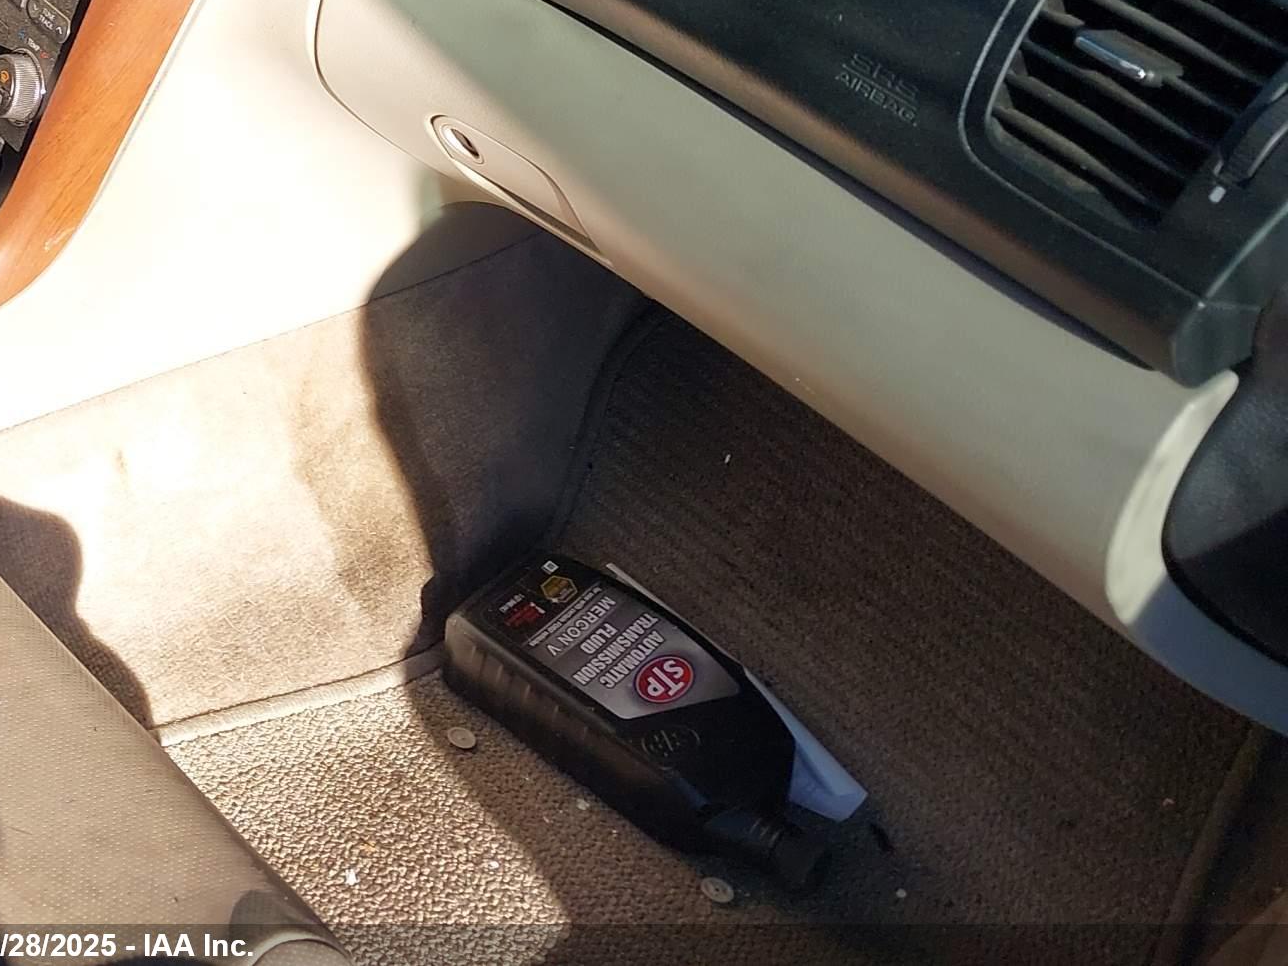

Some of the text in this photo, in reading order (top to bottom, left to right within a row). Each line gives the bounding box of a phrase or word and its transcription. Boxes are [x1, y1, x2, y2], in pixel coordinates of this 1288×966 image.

[835, 70, 918, 128] AIRBAG
[557, 596, 617, 647] MERCON
[579, 622, 619, 655] FLUID
[546, 643, 562, 657] V
[572, 613, 659, 685] TRANSMISSION
[599, 630, 665, 689] AUTOMATIC
[647, 660, 685, 697] STP
